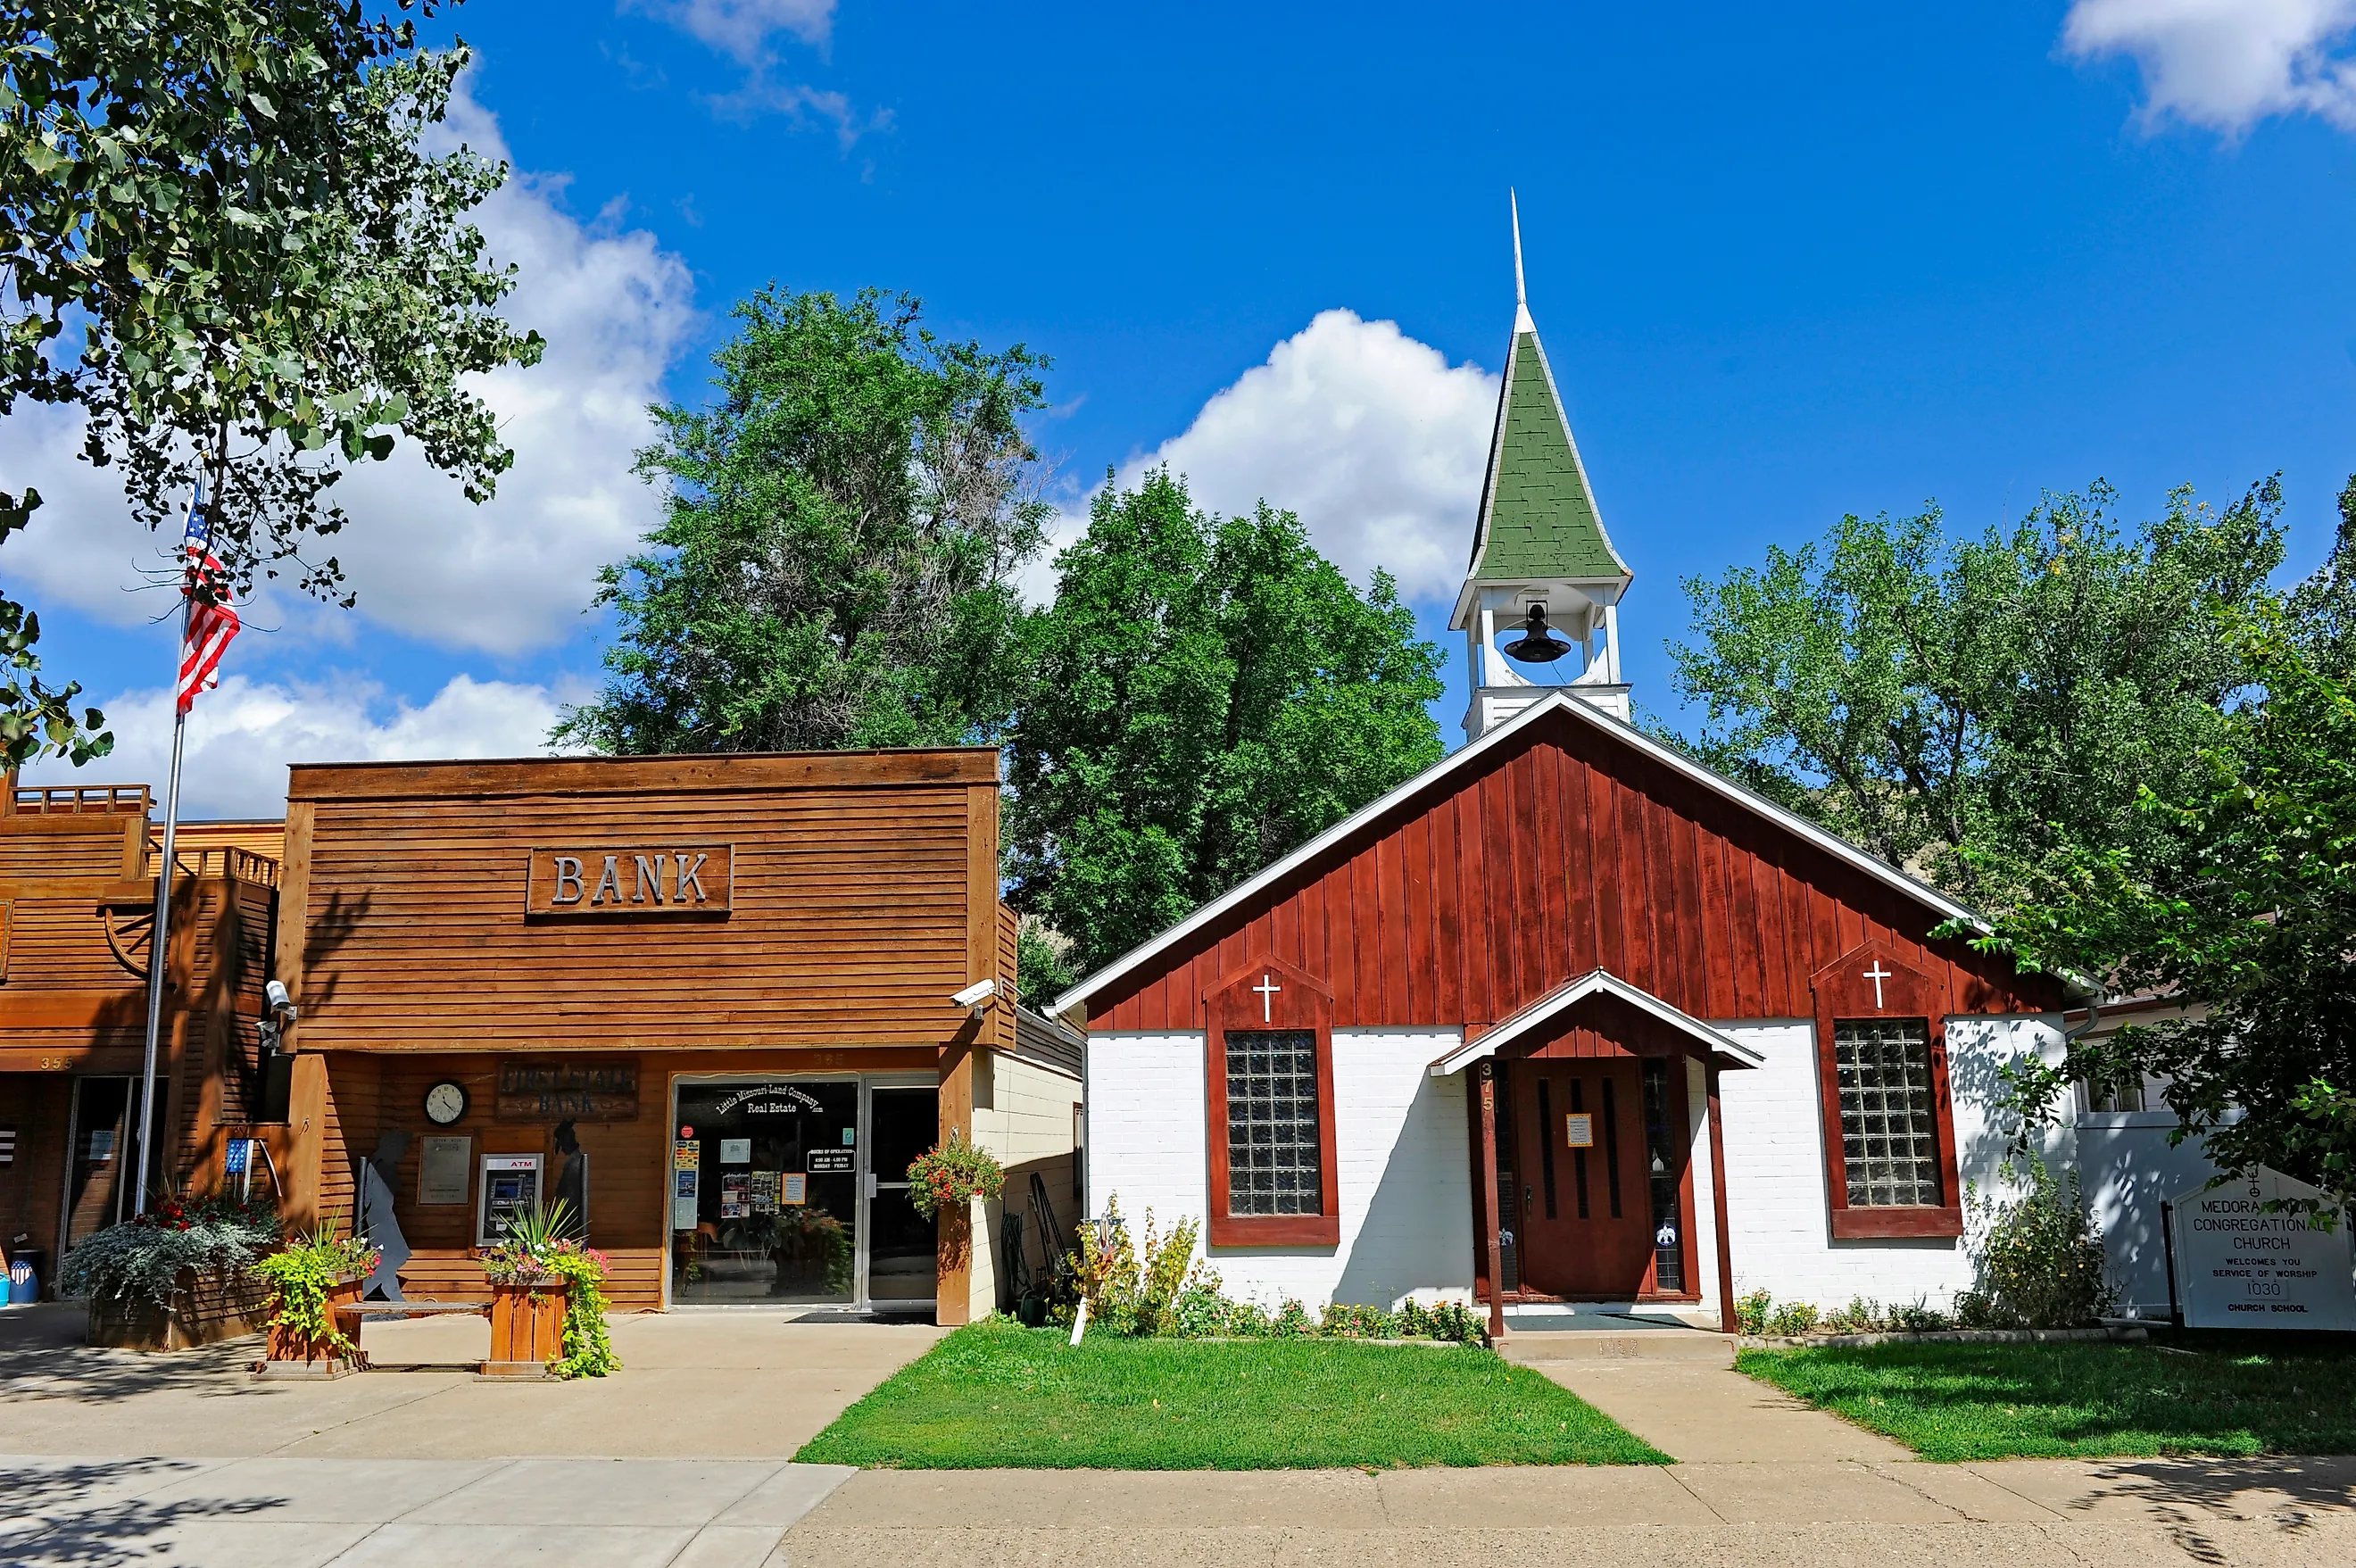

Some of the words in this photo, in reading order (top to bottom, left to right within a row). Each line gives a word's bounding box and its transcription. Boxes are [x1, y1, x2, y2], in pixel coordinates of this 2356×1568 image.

[552, 853, 708, 903] BANK
[40, 1057, 73, 1069] 355
[1481, 1062, 1493, 1111] 375
[538, 1094, 594, 1113] BANK
[716, 1097, 738, 1115] Little
[736, 1084, 767, 1101] Missouri
[768, 1084, 787, 1095] Land
[788, 1086, 818, 1109] Company
[747, 1103, 767, 1113] Real
[769, 1102, 797, 1113] Estate
[2201, 1200, 2261, 1214] MEDORA
[2233, 1237, 2291, 1250] CHURCH
[2225, 1258, 2276, 1266] WELCOMES
[2282, 1258, 2301, 1266] YOU
[2212, 1269, 2252, 1277] SERVICE
[2258, 1270, 2270, 1278] OF
[2276, 1270, 2318, 1278] WORSHIP
[2227, 1304, 2266, 1312] CHURCH
[2270, 1304, 2308, 1313] SCHOOL
